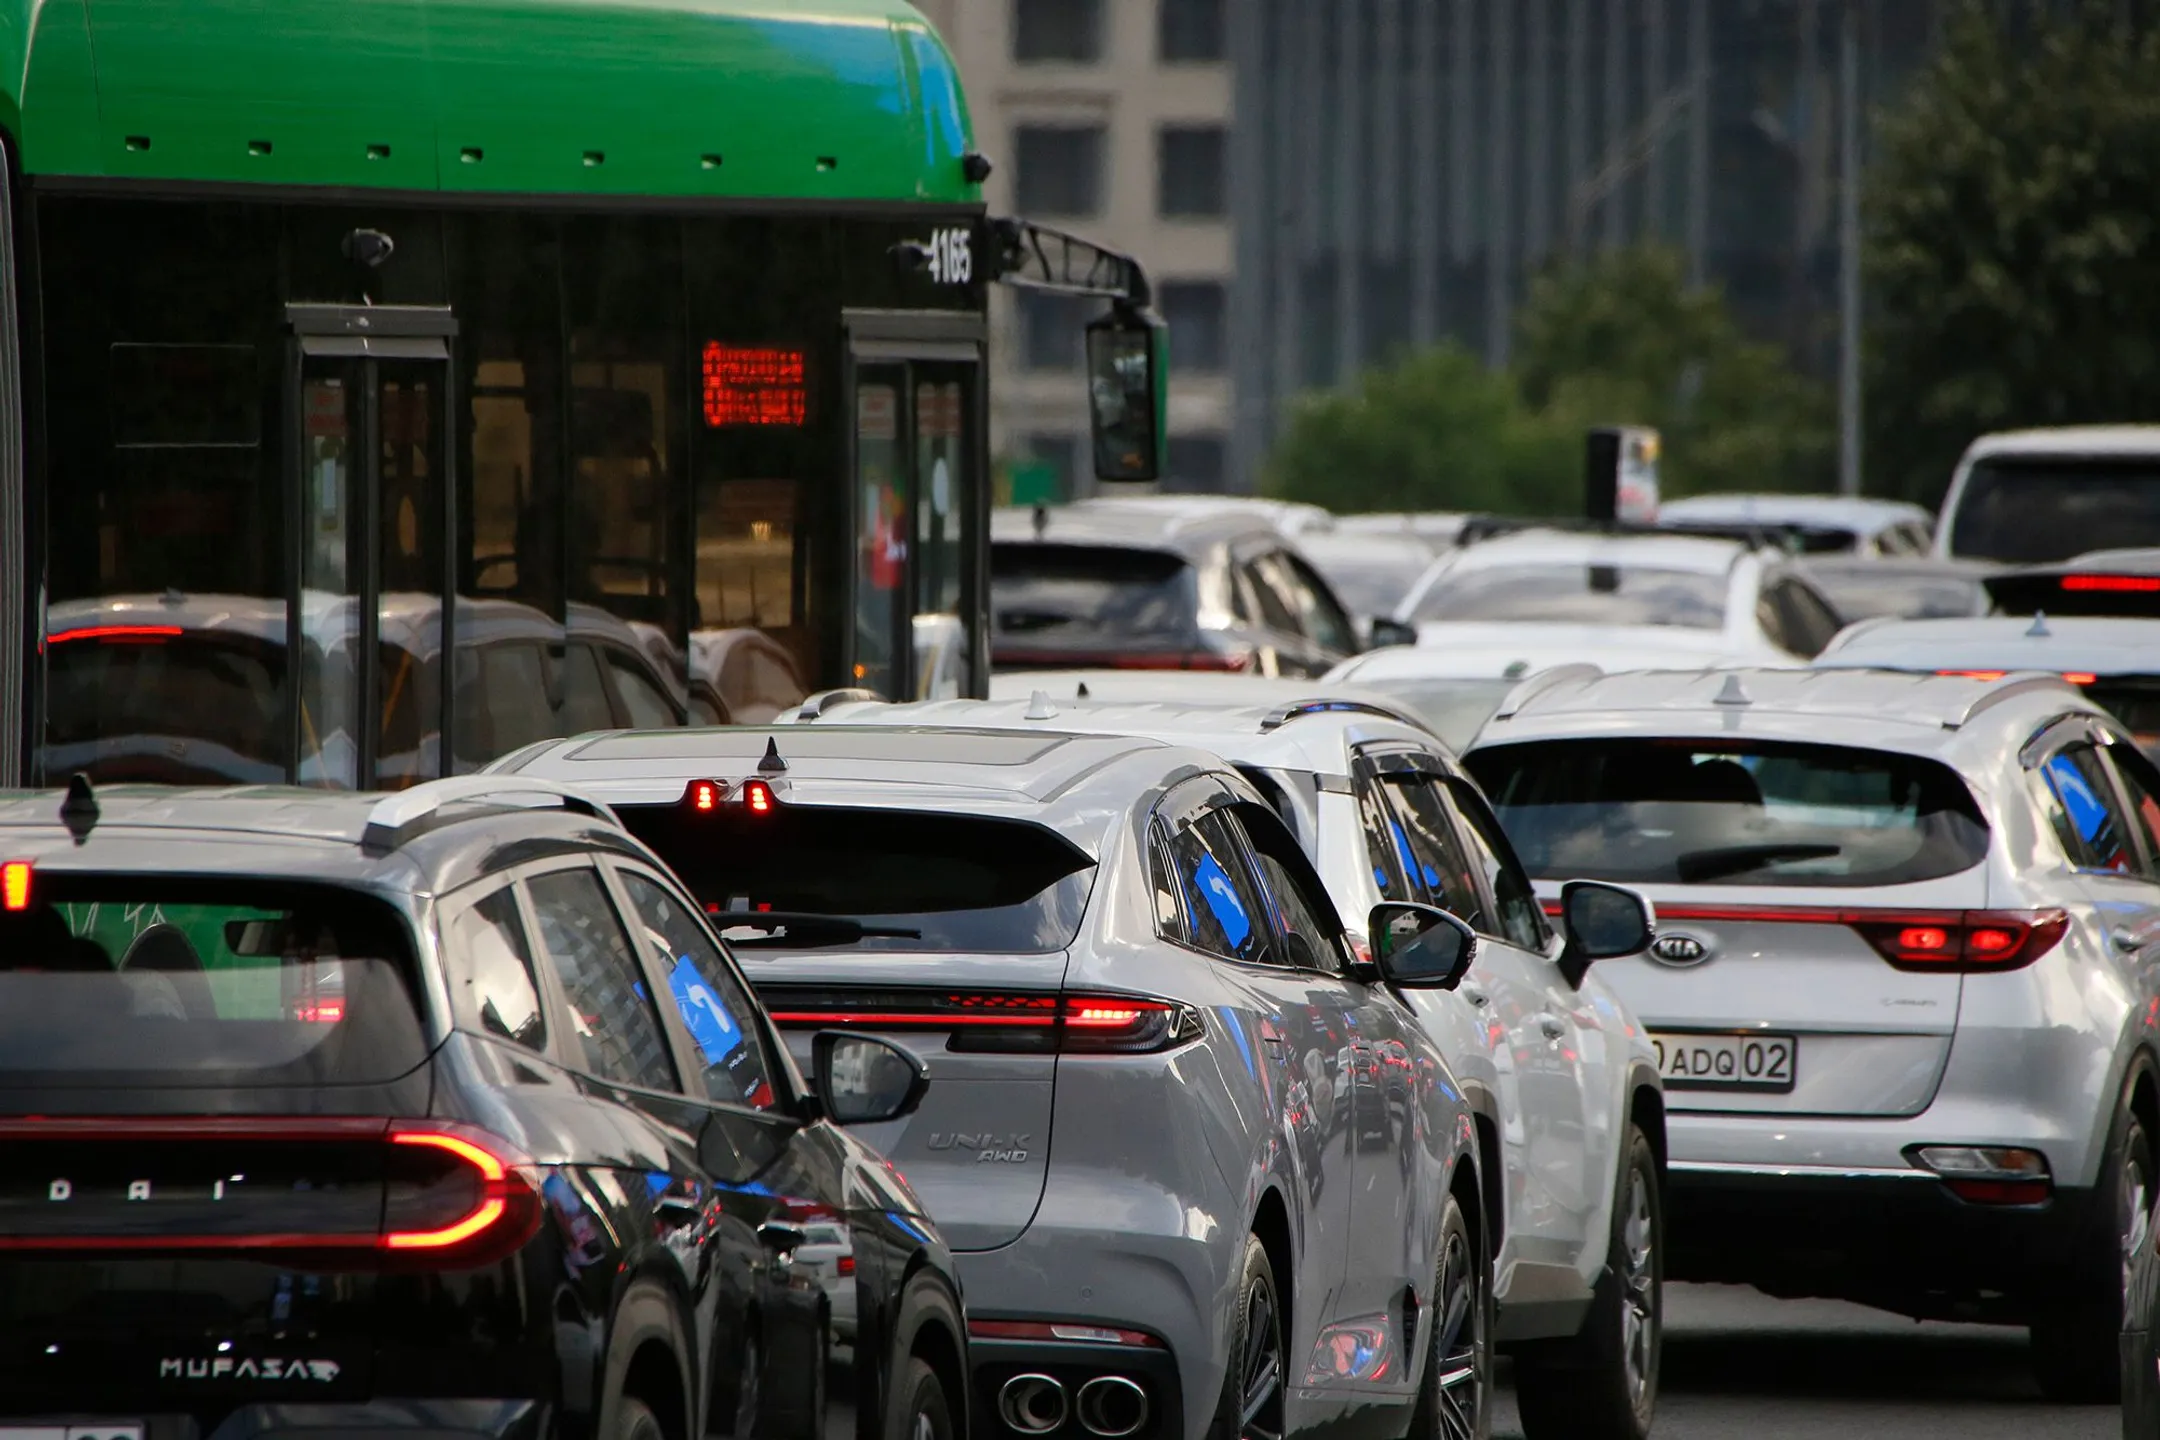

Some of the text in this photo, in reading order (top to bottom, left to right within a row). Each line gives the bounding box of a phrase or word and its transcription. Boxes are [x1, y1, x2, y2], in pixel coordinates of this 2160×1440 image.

[1658, 940, 1700, 958] KIA
[1670, 1048, 1734, 1076] ADQ
[1744, 1042, 1788, 1078] 02
[928, 1132, 1031, 1151] UNI-K
[976, 1150, 1028, 1162] AWD
[160, 1357, 309, 1379] MUFASA
